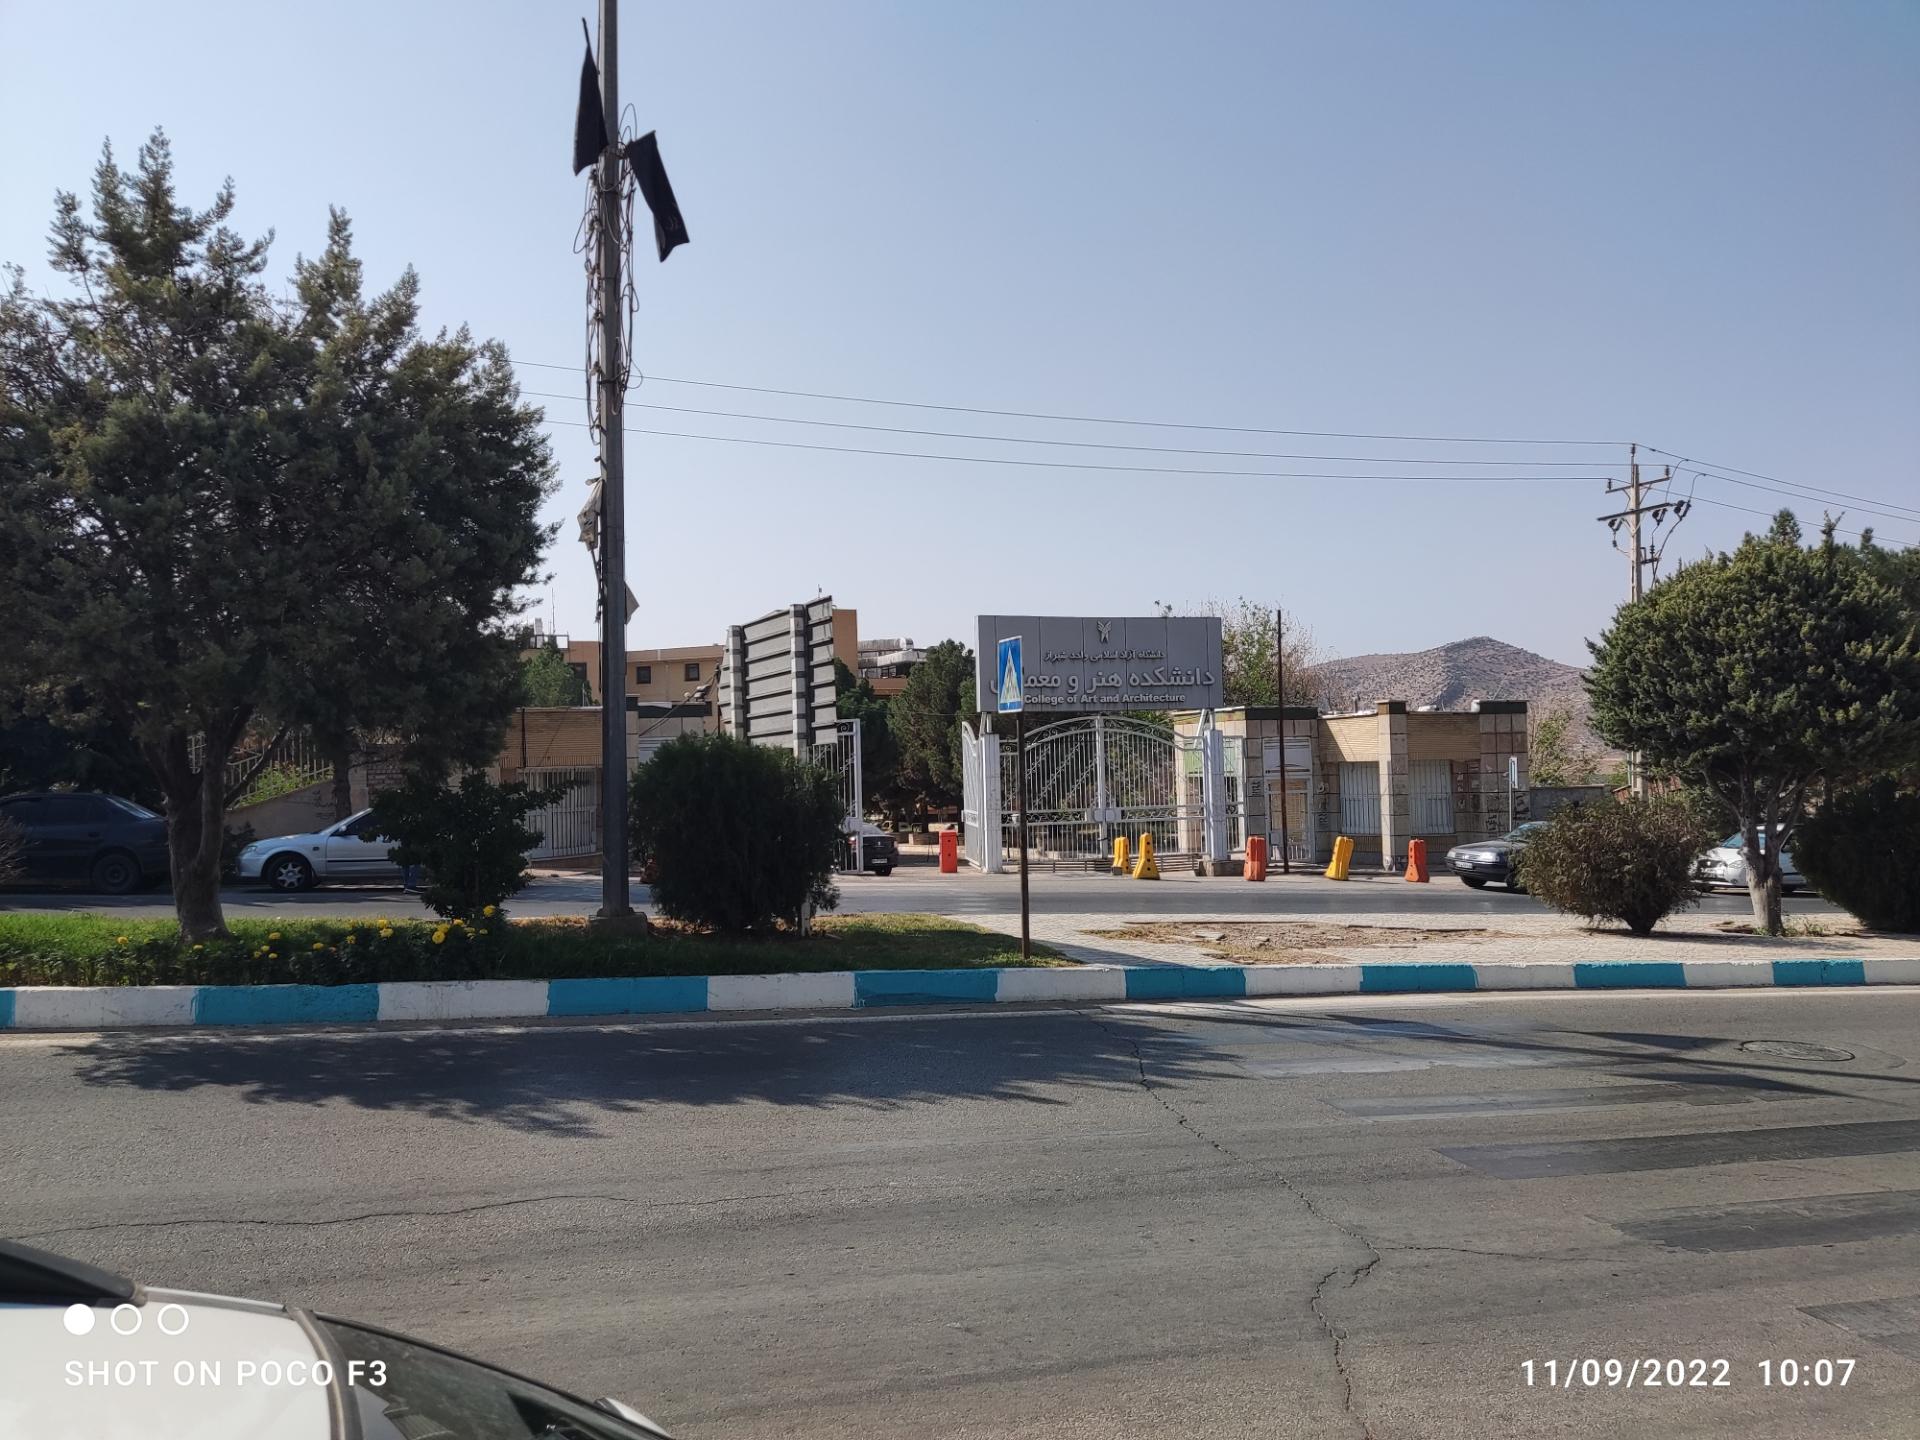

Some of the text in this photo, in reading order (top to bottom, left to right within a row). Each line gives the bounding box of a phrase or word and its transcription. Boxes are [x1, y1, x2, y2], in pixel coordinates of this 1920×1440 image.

[1043, 651, 1067, 662] شیراز
[1067, 675, 1079, 694] و
[1086, 671, 1122, 694] هنر
[1129, 666, 1215, 687] دانشکده
[1024, 693, 1186, 705] College of Art and Architecture
